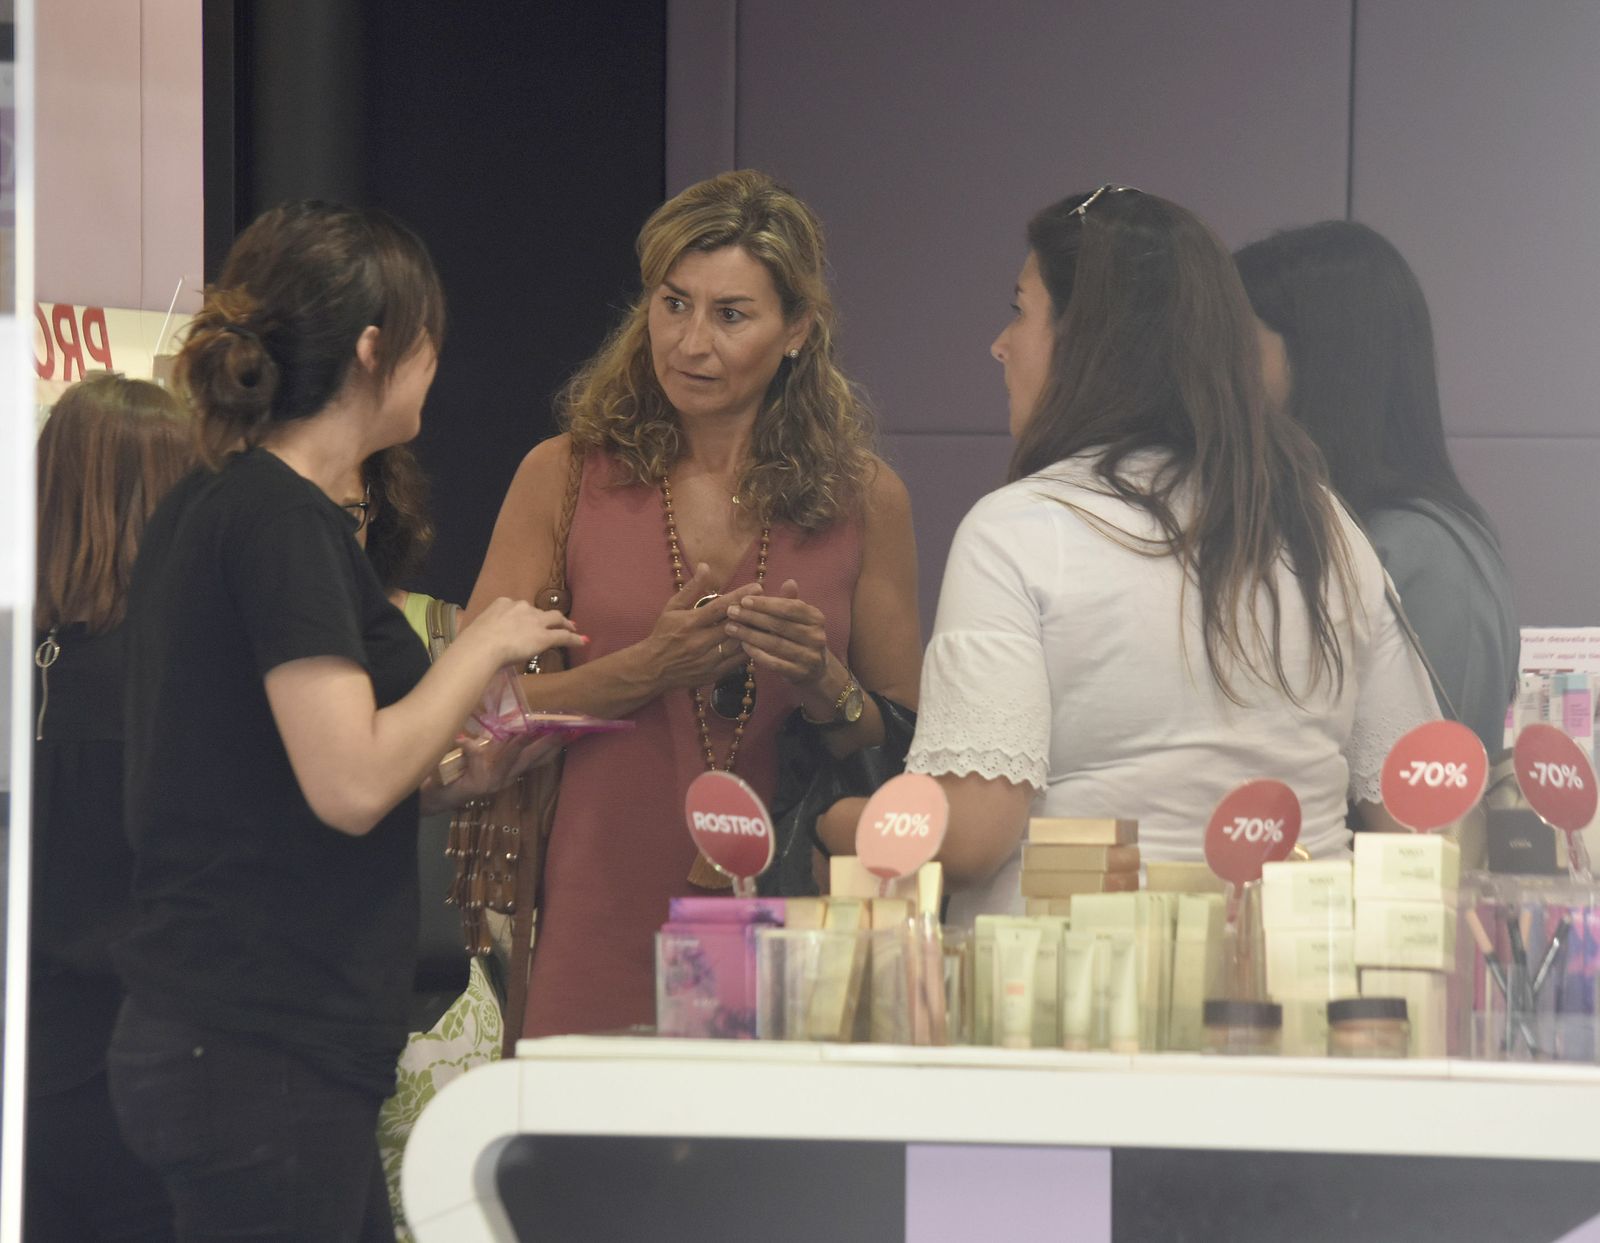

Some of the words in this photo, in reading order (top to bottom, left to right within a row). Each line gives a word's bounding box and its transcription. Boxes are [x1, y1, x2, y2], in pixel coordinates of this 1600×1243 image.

[1400, 761, 1468, 788] -70%
[1528, 761, 1584, 790] -70%
[692, 811, 766, 837] ROSTRO
[874, 812, 931, 837] -70%
[1223, 816, 1284, 842] -70%
